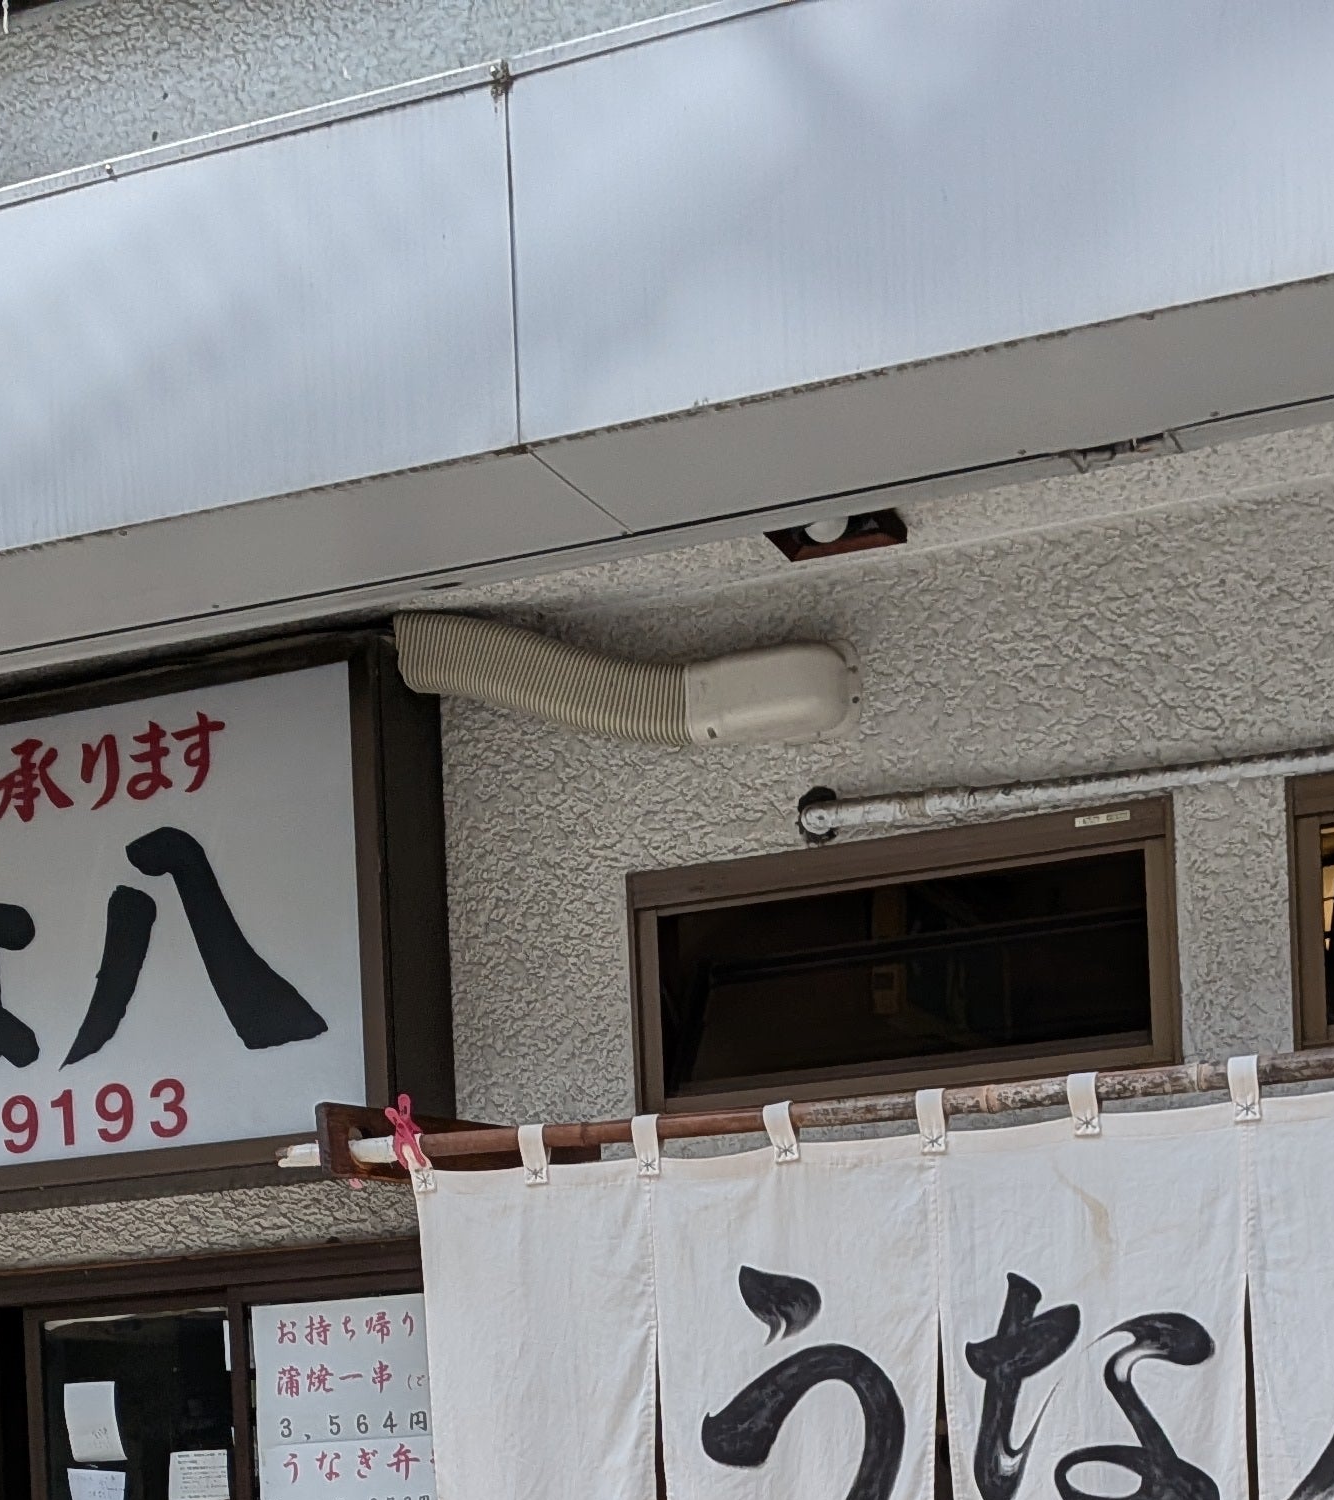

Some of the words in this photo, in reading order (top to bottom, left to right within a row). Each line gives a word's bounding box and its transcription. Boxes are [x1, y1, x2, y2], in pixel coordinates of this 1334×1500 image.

[276, 1312, 414, 1345] お持ち帰り
[276, 1360, 393, 1398] 蒲焼一串
[279, 1411, 428, 1441] 3,564円
[282, 1443, 436, 1483] うなぎ弁
